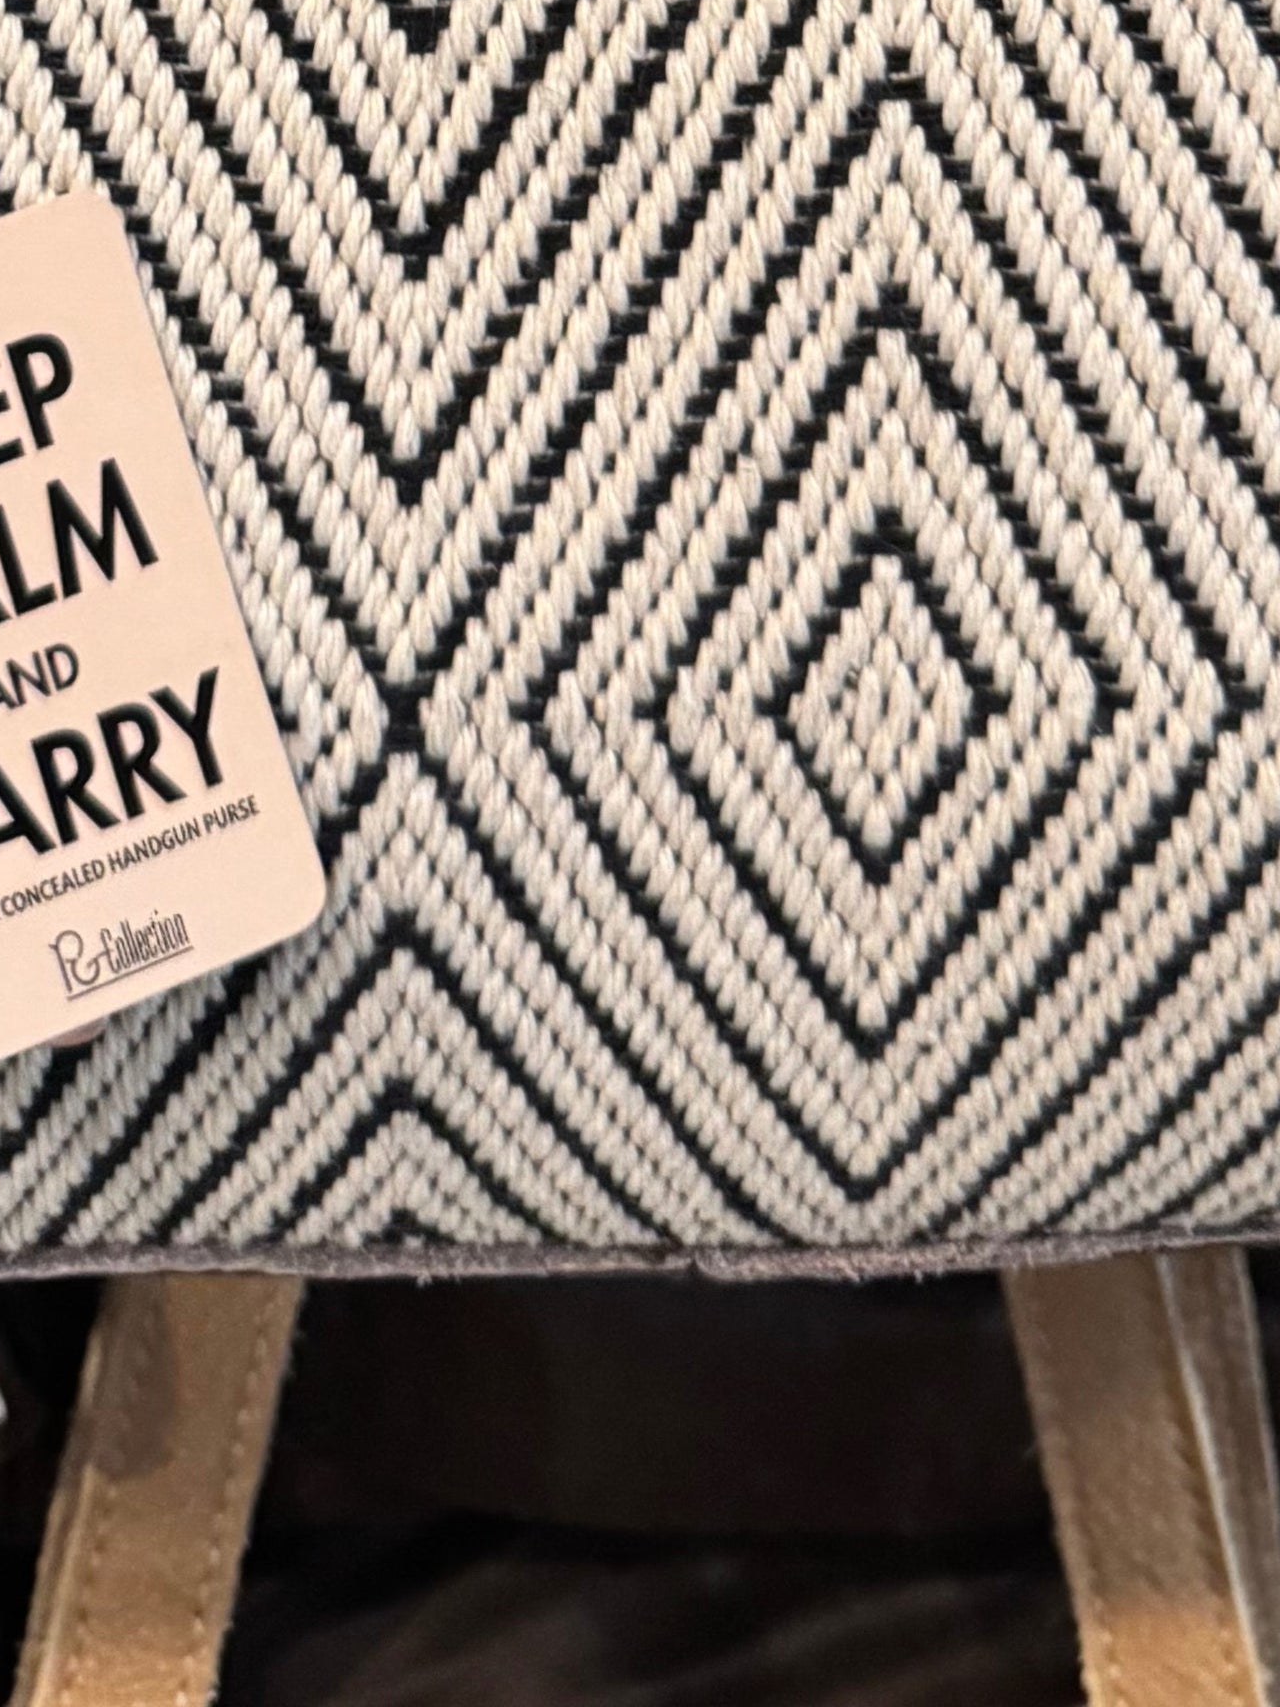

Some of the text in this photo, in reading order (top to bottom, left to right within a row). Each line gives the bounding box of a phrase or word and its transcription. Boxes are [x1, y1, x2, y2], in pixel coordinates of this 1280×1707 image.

[0, 859, 106, 918] CONCEALED
[107, 817, 201, 875] HANDGUN
[203, 794, 261, 835] PURSE
[99, 908, 190, 974] Collection
